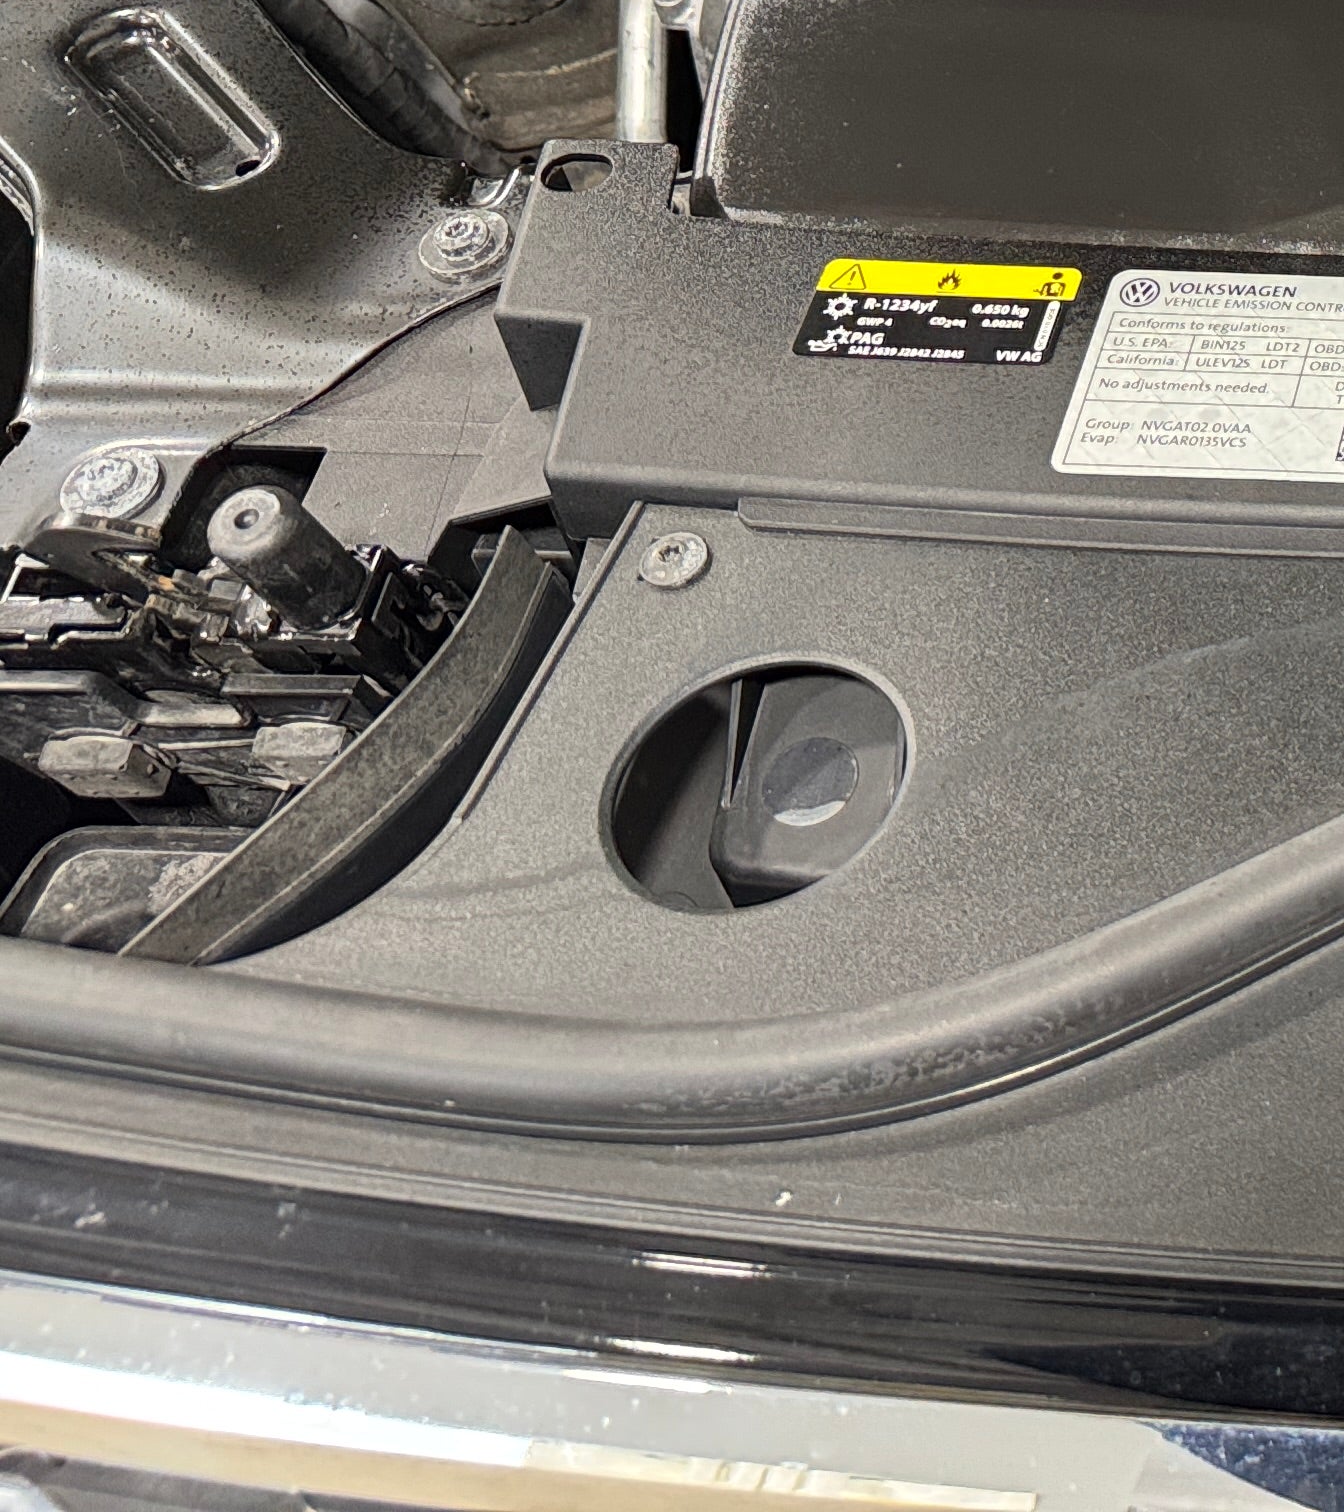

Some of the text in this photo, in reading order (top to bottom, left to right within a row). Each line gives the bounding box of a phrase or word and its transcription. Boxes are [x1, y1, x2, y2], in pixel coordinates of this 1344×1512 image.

[1168, 282, 1298, 299] VOLKSWAGEN
[864, 298, 938, 313] R-1234yf
[1011, 304, 1030, 319] kg
[1164, 297, 1220, 308] VEHICLE
[1224, 299, 1292, 310] EMISSION
[857, 316, 884, 327] GWP
[1119, 317, 1185, 329] Conforms
[1190, 320, 1204, 330] to
[851, 331, 885, 346] PAG
[1265, 341, 1300, 352] LDT2
[996, 350, 1021, 362] VW
[1022, 351, 1043, 363] AG
[1260, 359, 1288, 369] LDT
[1098, 377, 1270, 393] No adjustments needed.
